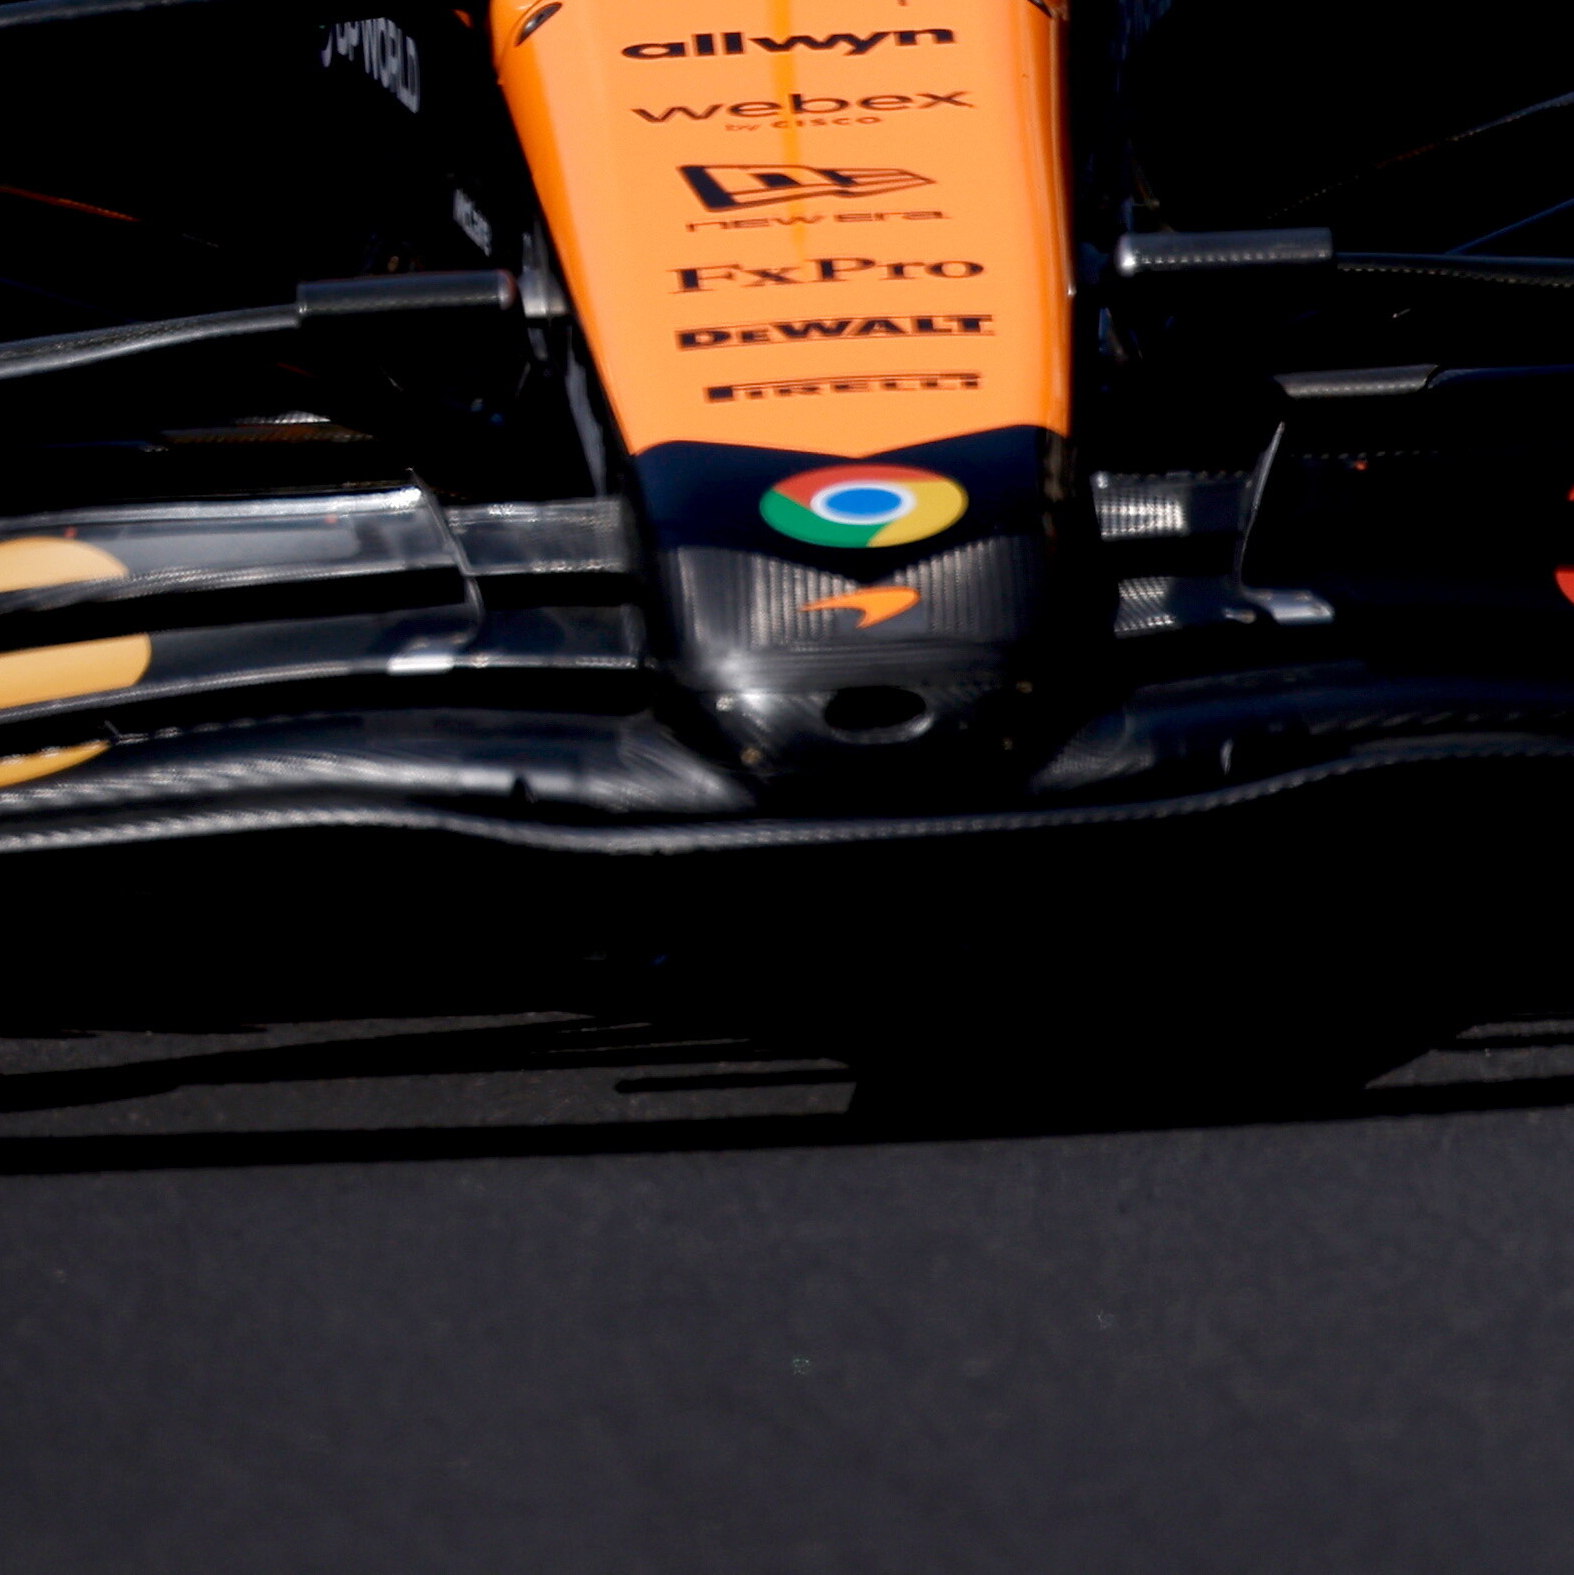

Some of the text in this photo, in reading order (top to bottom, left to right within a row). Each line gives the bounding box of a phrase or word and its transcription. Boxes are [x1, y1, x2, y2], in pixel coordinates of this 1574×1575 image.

[621, 27, 957, 60] allwyn
[631, 90, 975, 124] webex
[666, 257, 985, 295] FxPro
[703, 372, 982, 404] PIRELLI
